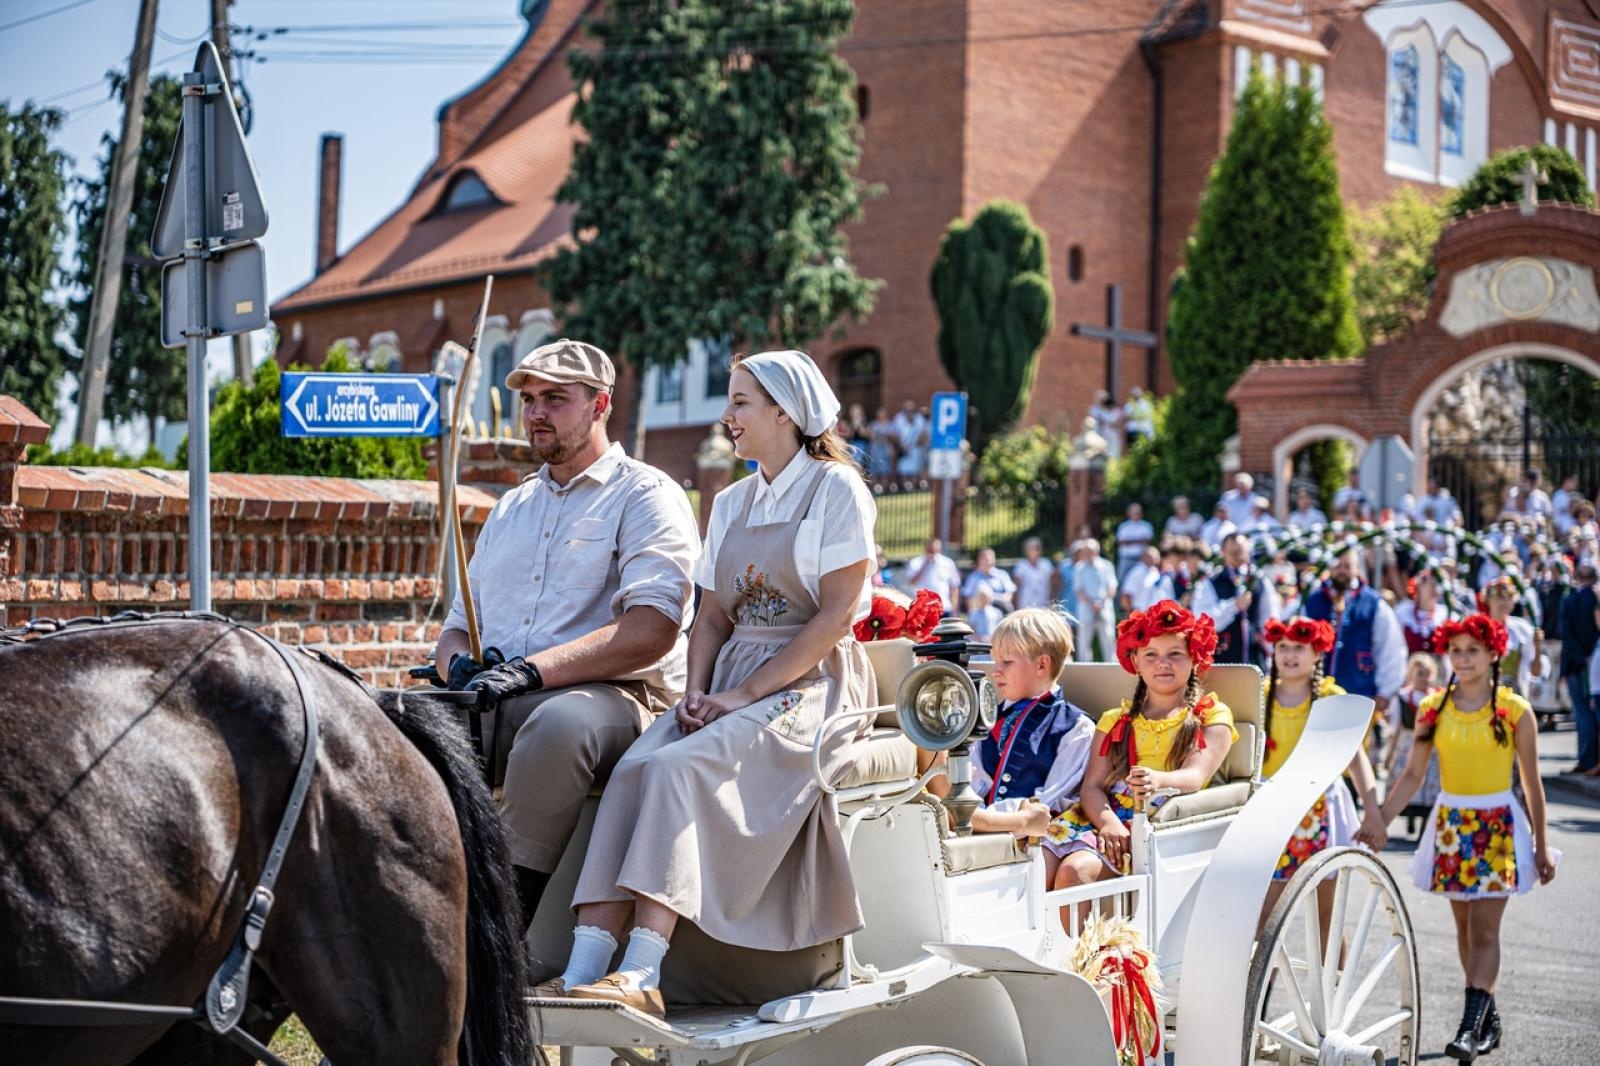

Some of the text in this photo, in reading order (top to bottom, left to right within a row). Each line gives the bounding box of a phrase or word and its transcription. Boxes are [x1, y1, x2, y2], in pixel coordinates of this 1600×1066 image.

[305, 395, 420, 428] ul. Józefa Gawliny
[938, 398, 959, 435] P
